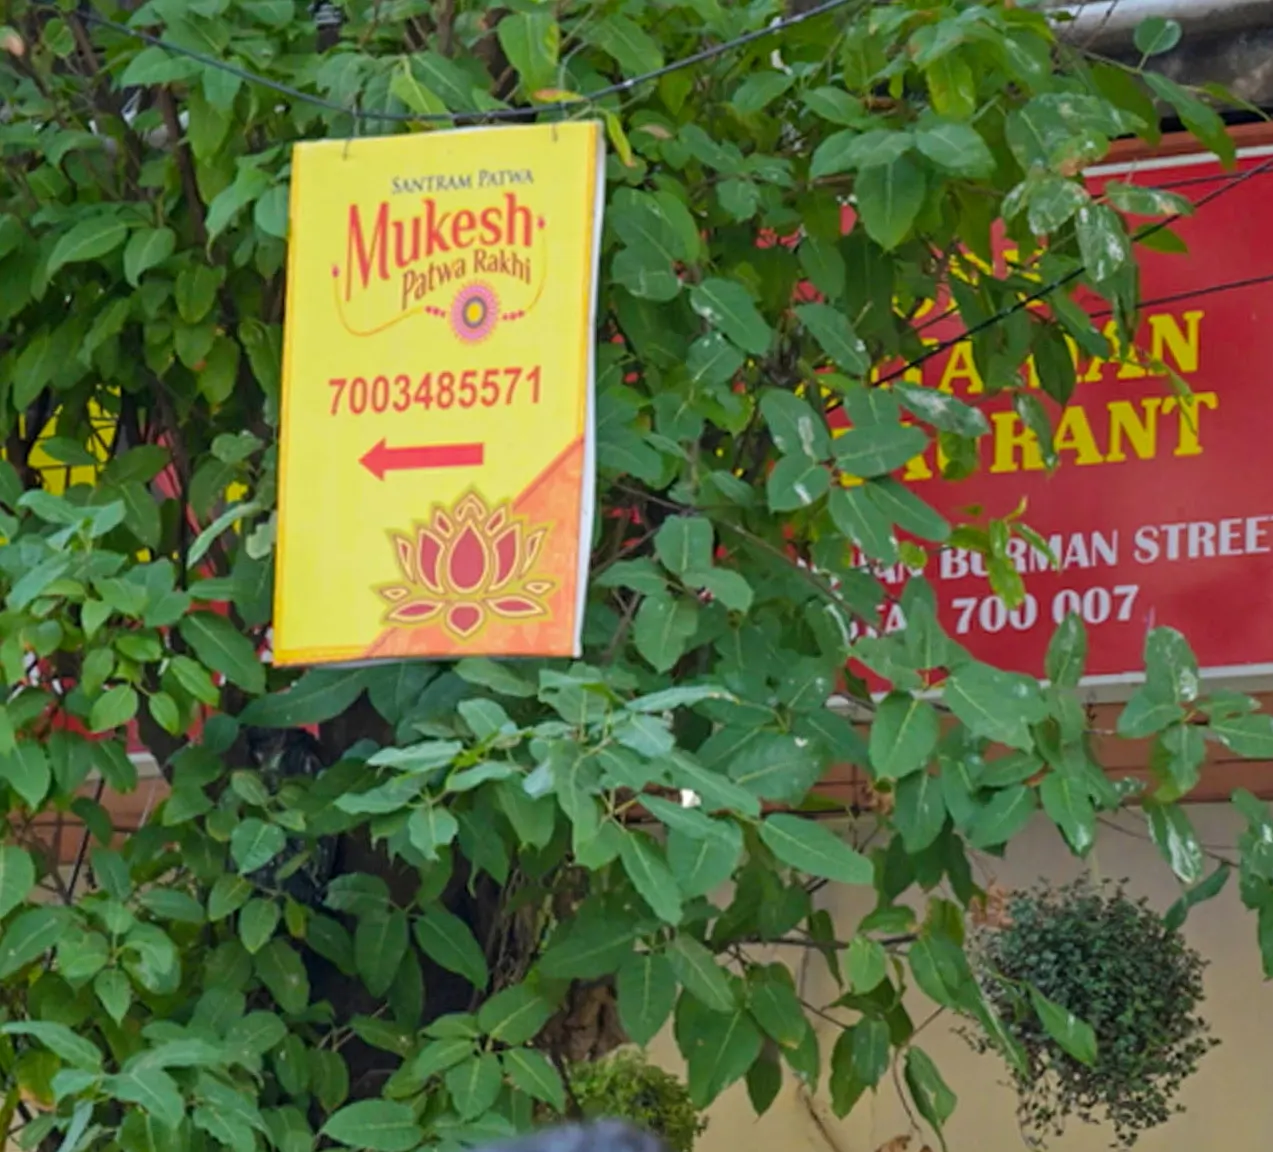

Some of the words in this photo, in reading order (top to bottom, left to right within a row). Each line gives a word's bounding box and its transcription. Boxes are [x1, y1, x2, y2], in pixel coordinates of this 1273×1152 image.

[392, 174, 472, 195] SANTRAM
[477, 169, 534, 187] PATWA
[345, 192, 533, 302] Mukesh
[402, 257, 466, 310] Patwa
[473, 248, 531, 286] Rakhi
[328, 366, 542, 416] 7003485571
[951, 592, 1038, 634] 700
[1052, 584, 1139, 626] 007
